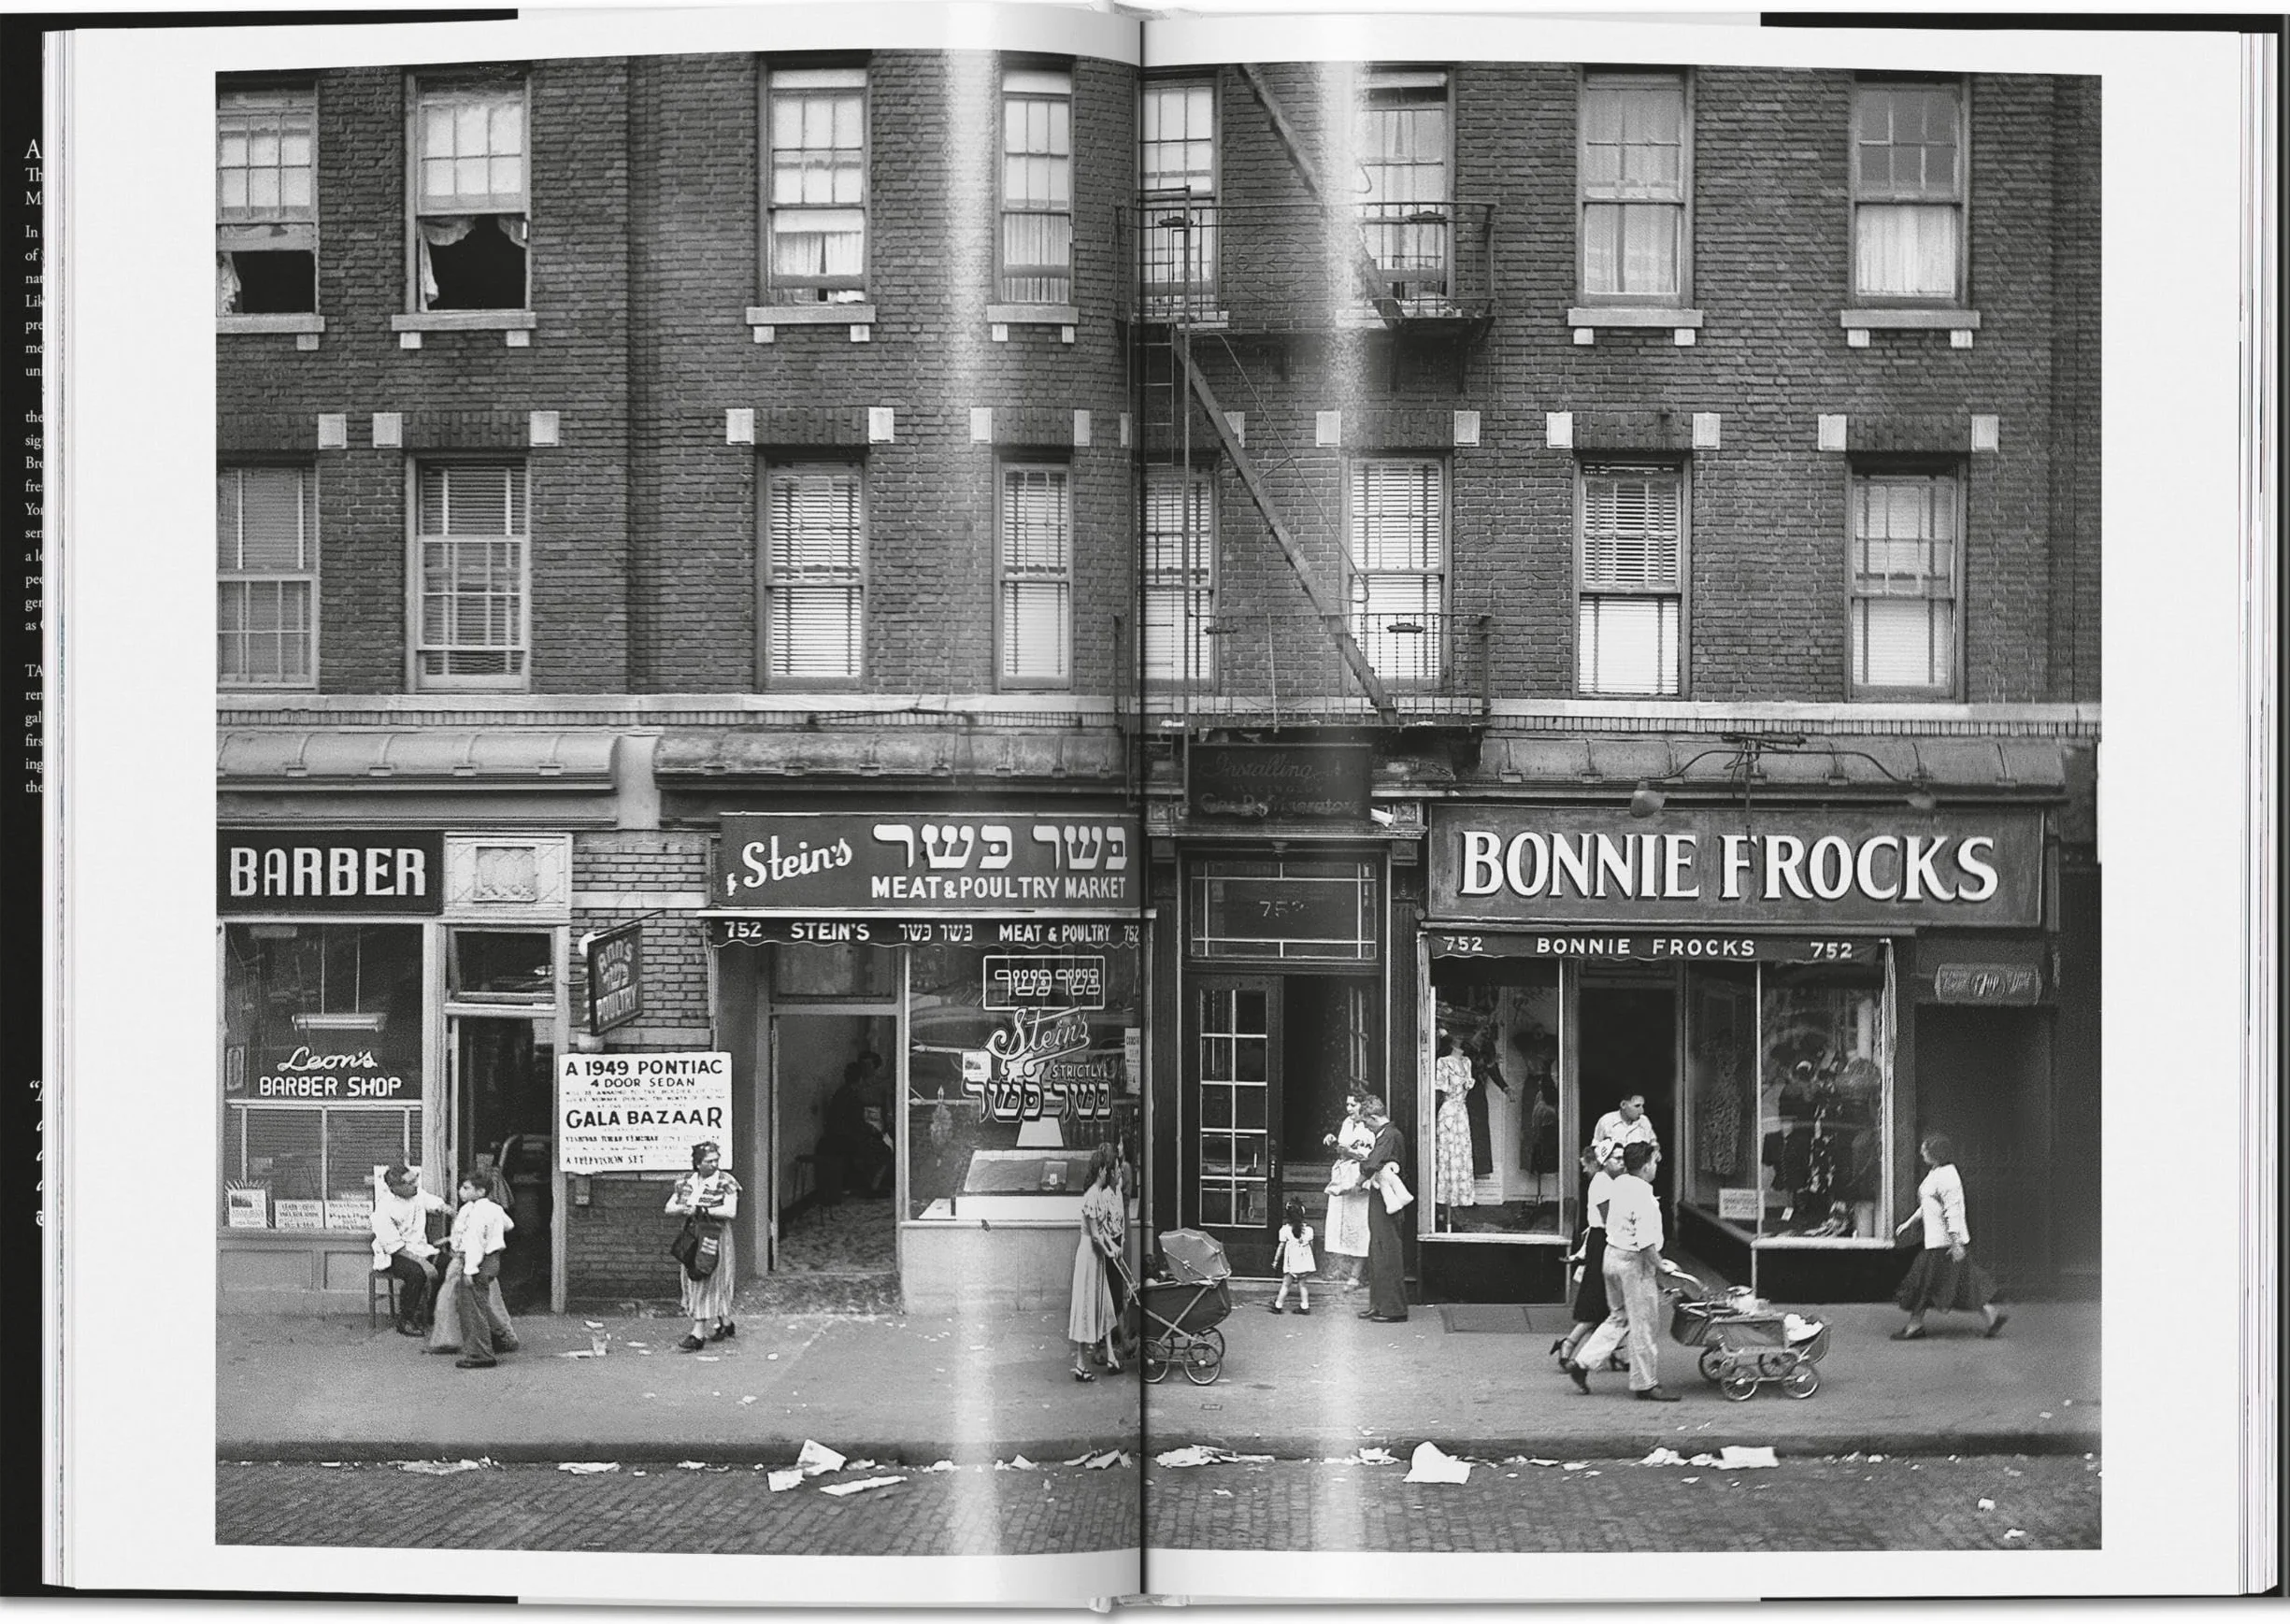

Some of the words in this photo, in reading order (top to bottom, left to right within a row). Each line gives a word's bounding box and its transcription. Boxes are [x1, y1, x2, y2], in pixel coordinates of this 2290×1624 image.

[25, 191, 43, 206] M
[25, 225, 38, 237] In
[24, 249, 39, 261] of
[25, 367, 43, 377] un
[24, 434, 44, 449] sig
[24, 552, 32, 562] a
[25, 621, 36, 631] as
[24, 663, 43, 677] TA
[742, 834, 852, 889] Stein's
[1461, 831, 1699, 898] BONNIE
[1721, 834, 1999, 901] FROCKS
[230, 848, 425, 897] BARBER
[1065, 876, 1125, 899] MARKET
[724, 921, 762, 938] 752
[791, 922, 870, 940] STEIN'S
[999, 924, 1042, 942] MEAT
[1048, 927, 1057, 942] &
[1062, 924, 1110, 943] POULTRY
[1124, 925, 1139, 943] 752
[1443, 937, 1483, 951] 752
[1537, 937, 1631, 954] BONNIE
[1653, 938, 1754, 957] FROCKS
[1810, 942, 1853, 960] 752
[985, 1006, 1091, 1076] Stein's
[278, 1046, 379, 1072] Leon's
[565, 1061, 579, 1076] A
[585, 1060, 629, 1076] 1949
[638, 1059, 723, 1076] PONTIAC
[1052, 1063, 1103, 1078] STRICTLY
[259, 1076, 338, 1097] BARBER
[346, 1076, 402, 1097] SHOP
[590, 1078, 599, 1088] 4
[604, 1077, 641, 1088] DOOR
[649, 1077, 695, 1088] SEDAN
[565, 1109, 621, 1129] GALA
[627, 1106, 723, 1129] BAZAAR
